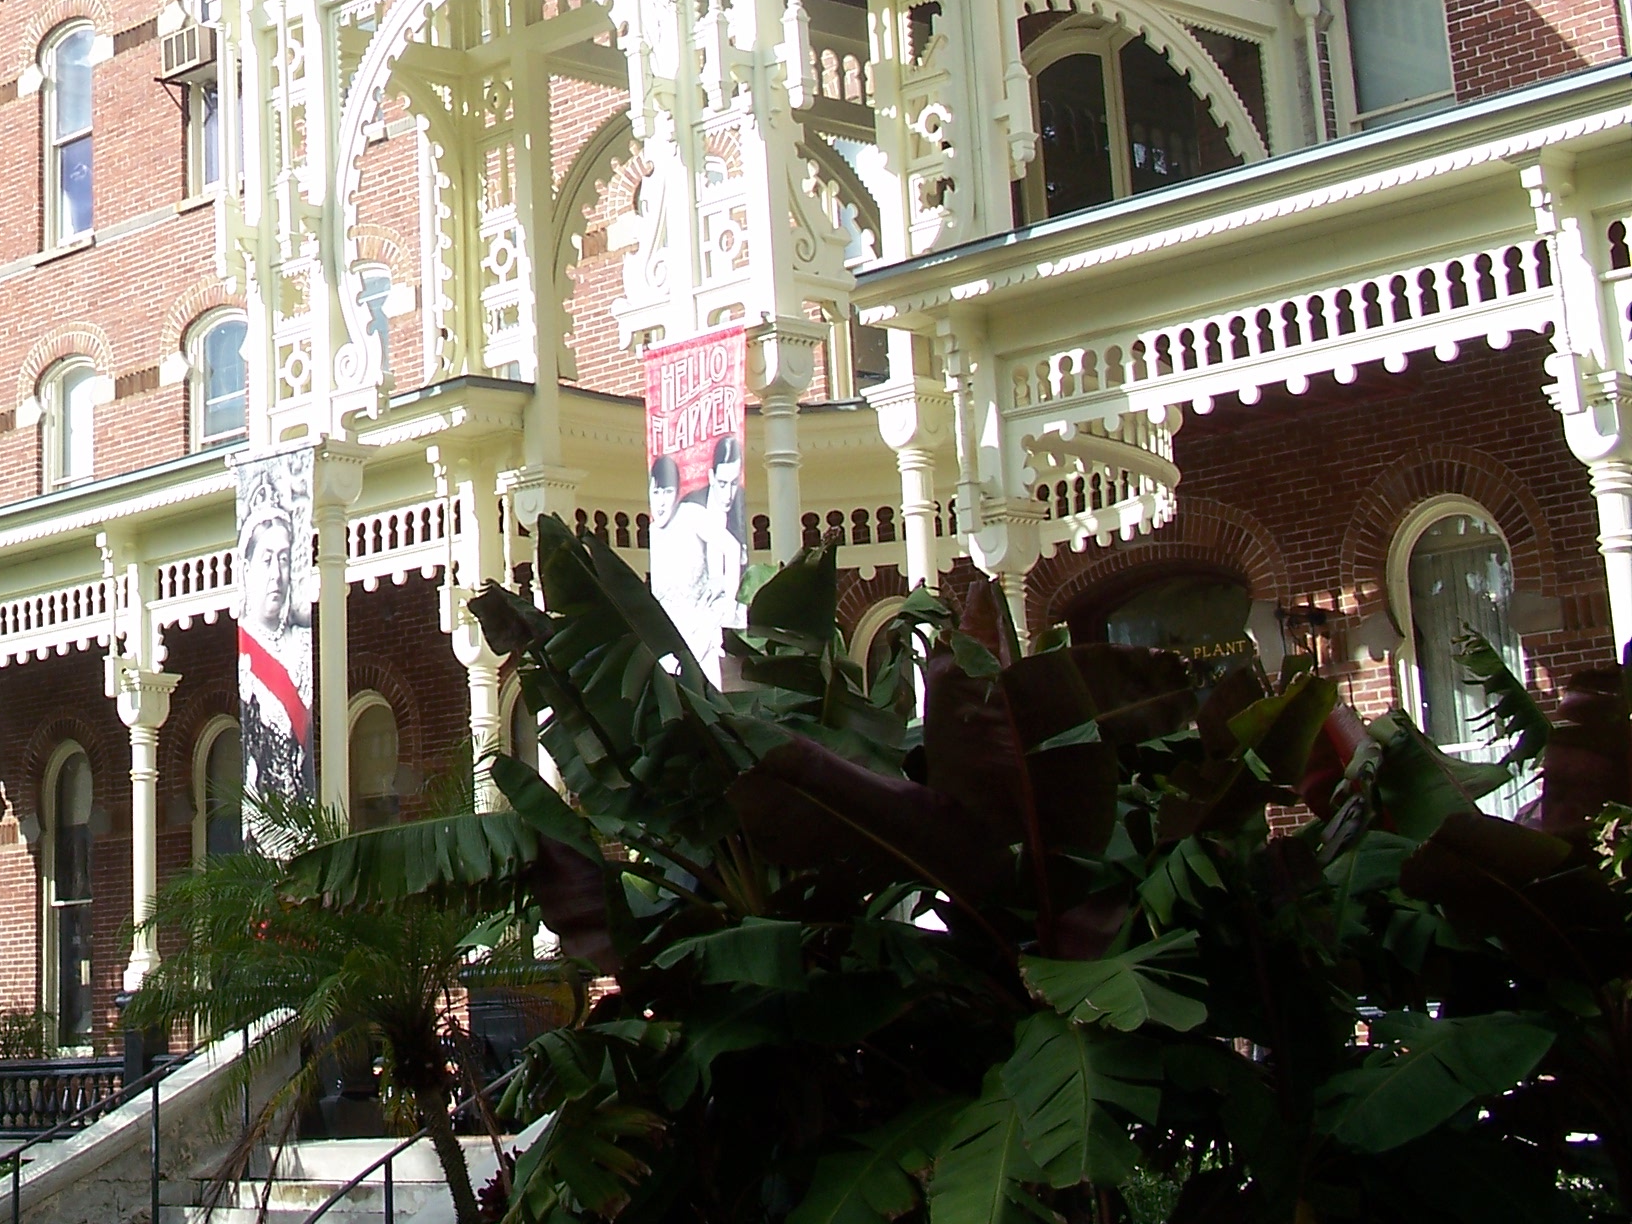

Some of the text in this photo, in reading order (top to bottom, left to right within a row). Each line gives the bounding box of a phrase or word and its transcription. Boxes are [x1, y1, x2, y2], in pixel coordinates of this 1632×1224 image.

[660, 345, 728, 413] HELLO
[651, 385, 738, 457] FLAPPER
[1193, 640, 1246, 659] PLANT
